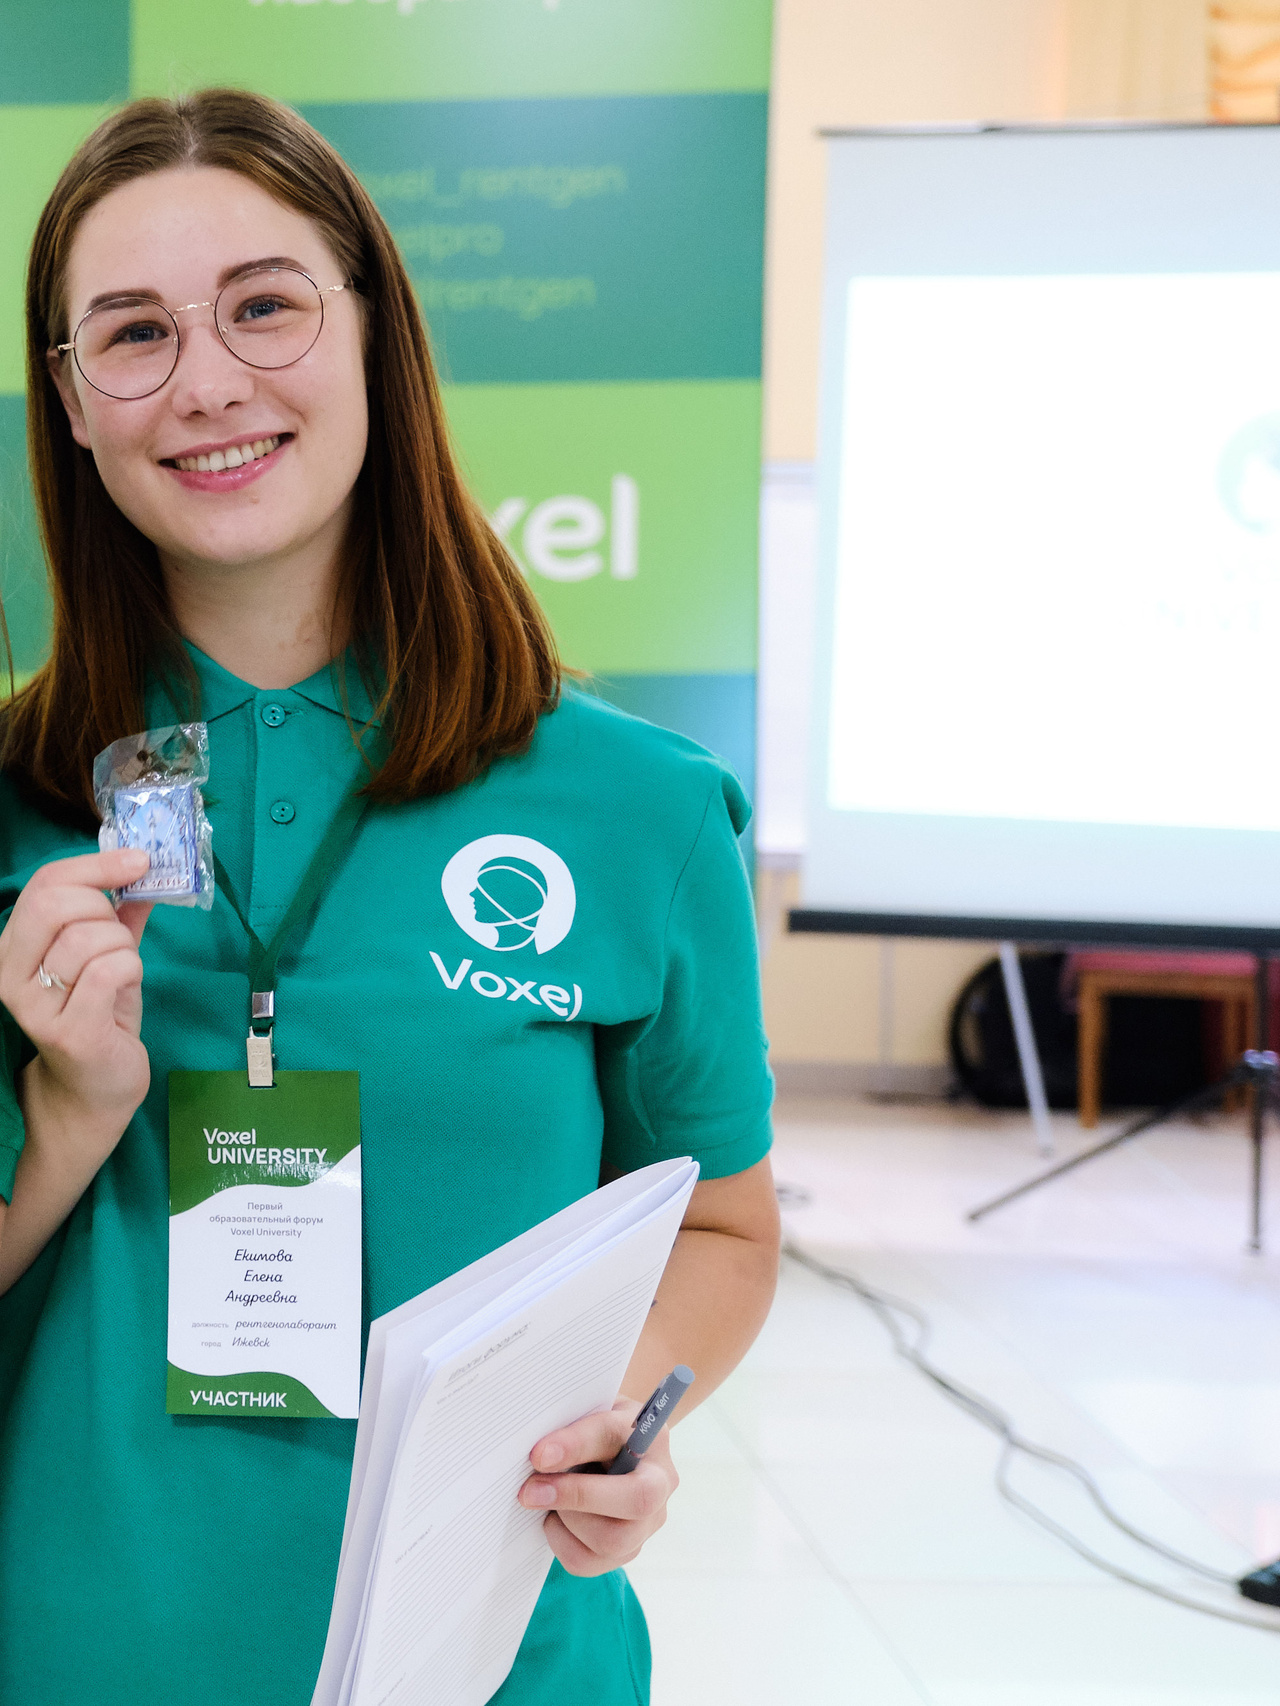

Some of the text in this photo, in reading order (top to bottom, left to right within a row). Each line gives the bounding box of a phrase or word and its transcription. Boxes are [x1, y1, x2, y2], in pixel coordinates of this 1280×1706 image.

[429, 951, 582, 1021] Voxel
[203, 1128, 256, 1145] Voxel
[207, 1147, 327, 1165] UNIVERSITY
[247, 1202, 283, 1211] Первый
[209, 1215, 323, 1225] образовательный форум
[231, 1228, 302, 1238] Voxel University
[234, 1248, 293, 1262] Екимова
[243, 1270, 283, 1283] Елена
[225, 1290, 298, 1306] Андреевна
[235, 1319, 337, 1332] рентгенолаборант
[232, 1337, 270, 1348] Ижевск
[190, 1390, 287, 1408] УЧАСТНИК
